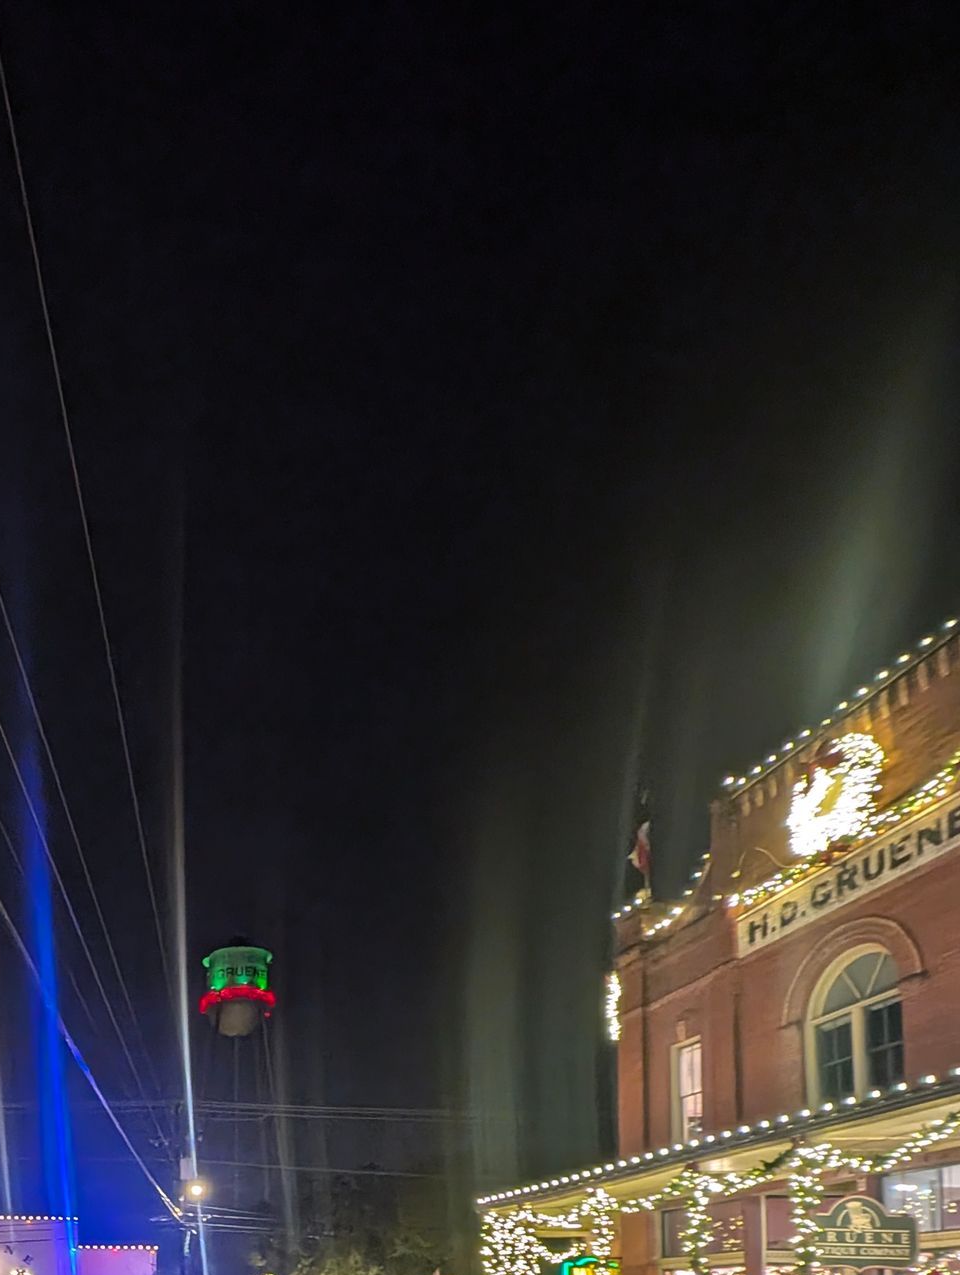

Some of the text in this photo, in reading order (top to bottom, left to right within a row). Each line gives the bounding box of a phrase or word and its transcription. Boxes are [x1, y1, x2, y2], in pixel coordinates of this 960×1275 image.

[217, 966, 267, 980] GRUENE
[814, 1231, 910, 1245] RUENE
[860, 1248, 910, 1257] COMPANY
